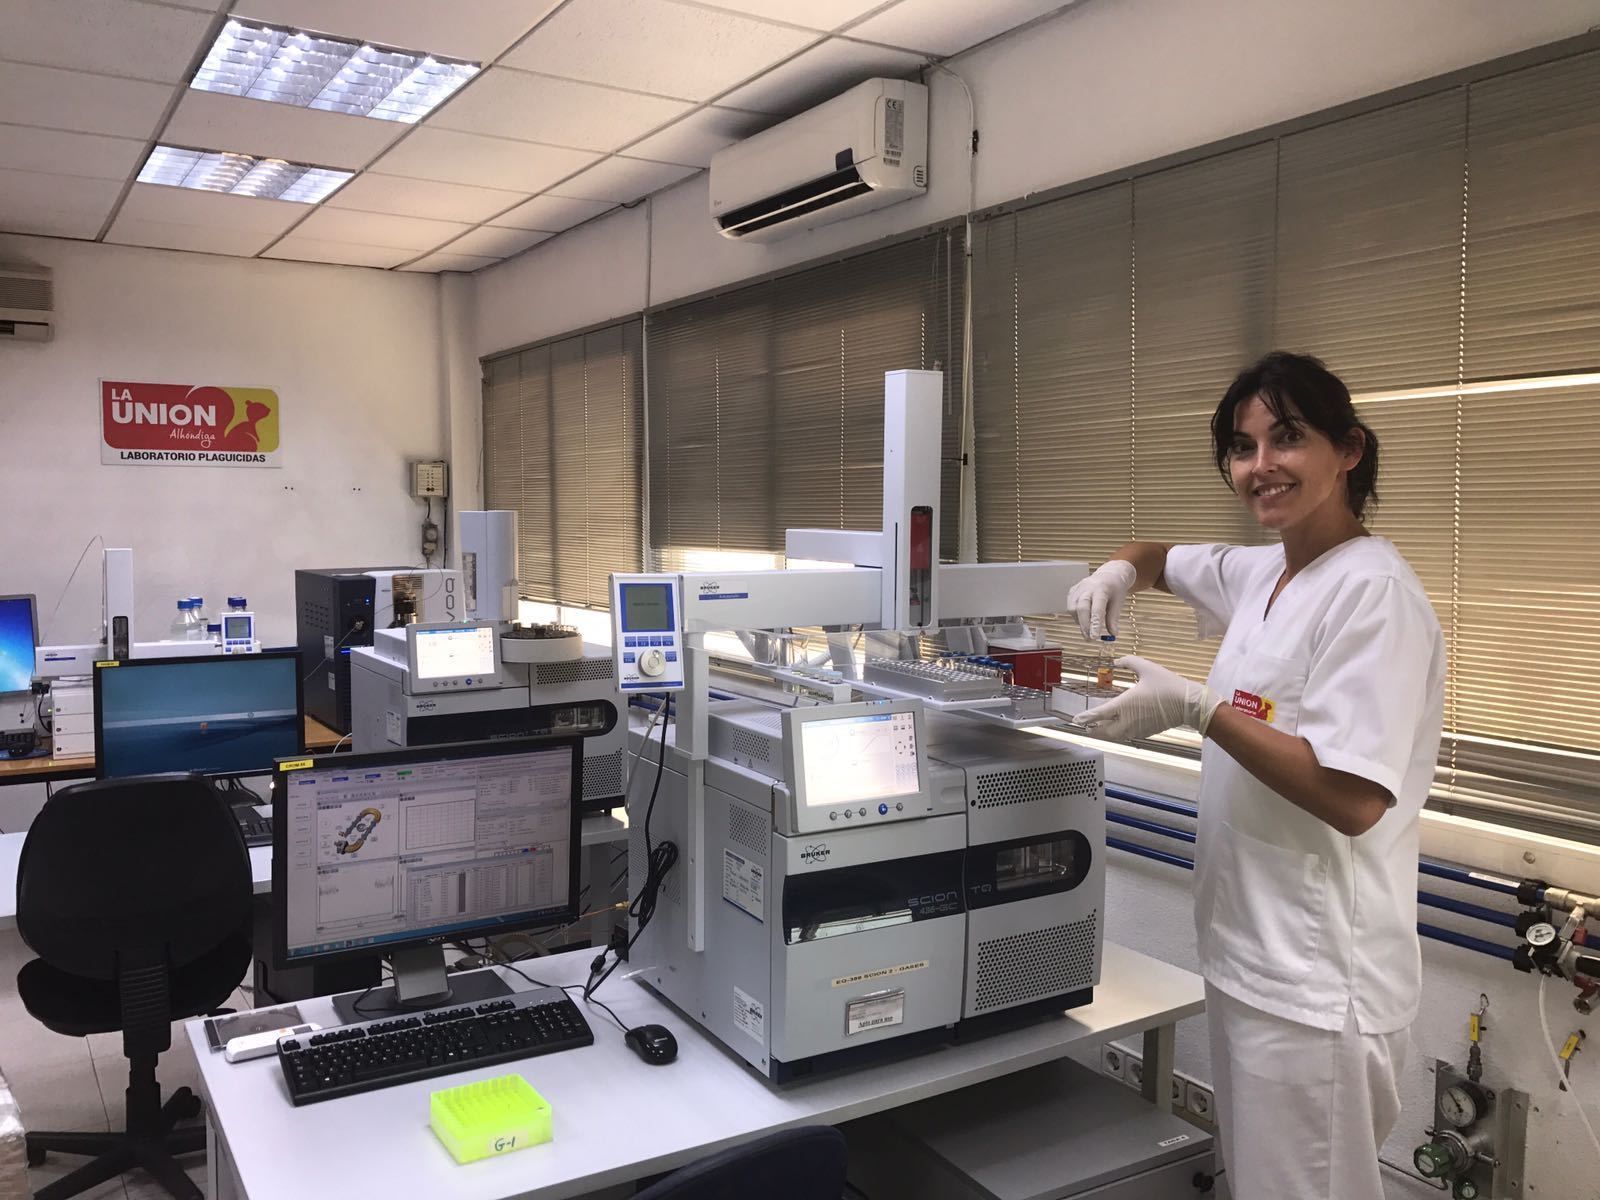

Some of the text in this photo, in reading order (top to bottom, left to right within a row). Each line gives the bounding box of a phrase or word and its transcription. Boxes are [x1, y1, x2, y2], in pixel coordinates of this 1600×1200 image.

[111, 388, 132, 401] LA
[112, 402, 216, 426] UNION
[120, 451, 266, 463] LABORATORIO PLAGUICIDAS
[1234, 696, 1258, 710] UNION
[800, 849, 831, 859] BRUKER
[907, 883, 992, 907] SCION TQ
[495, 1136, 516, 1152] G-1
